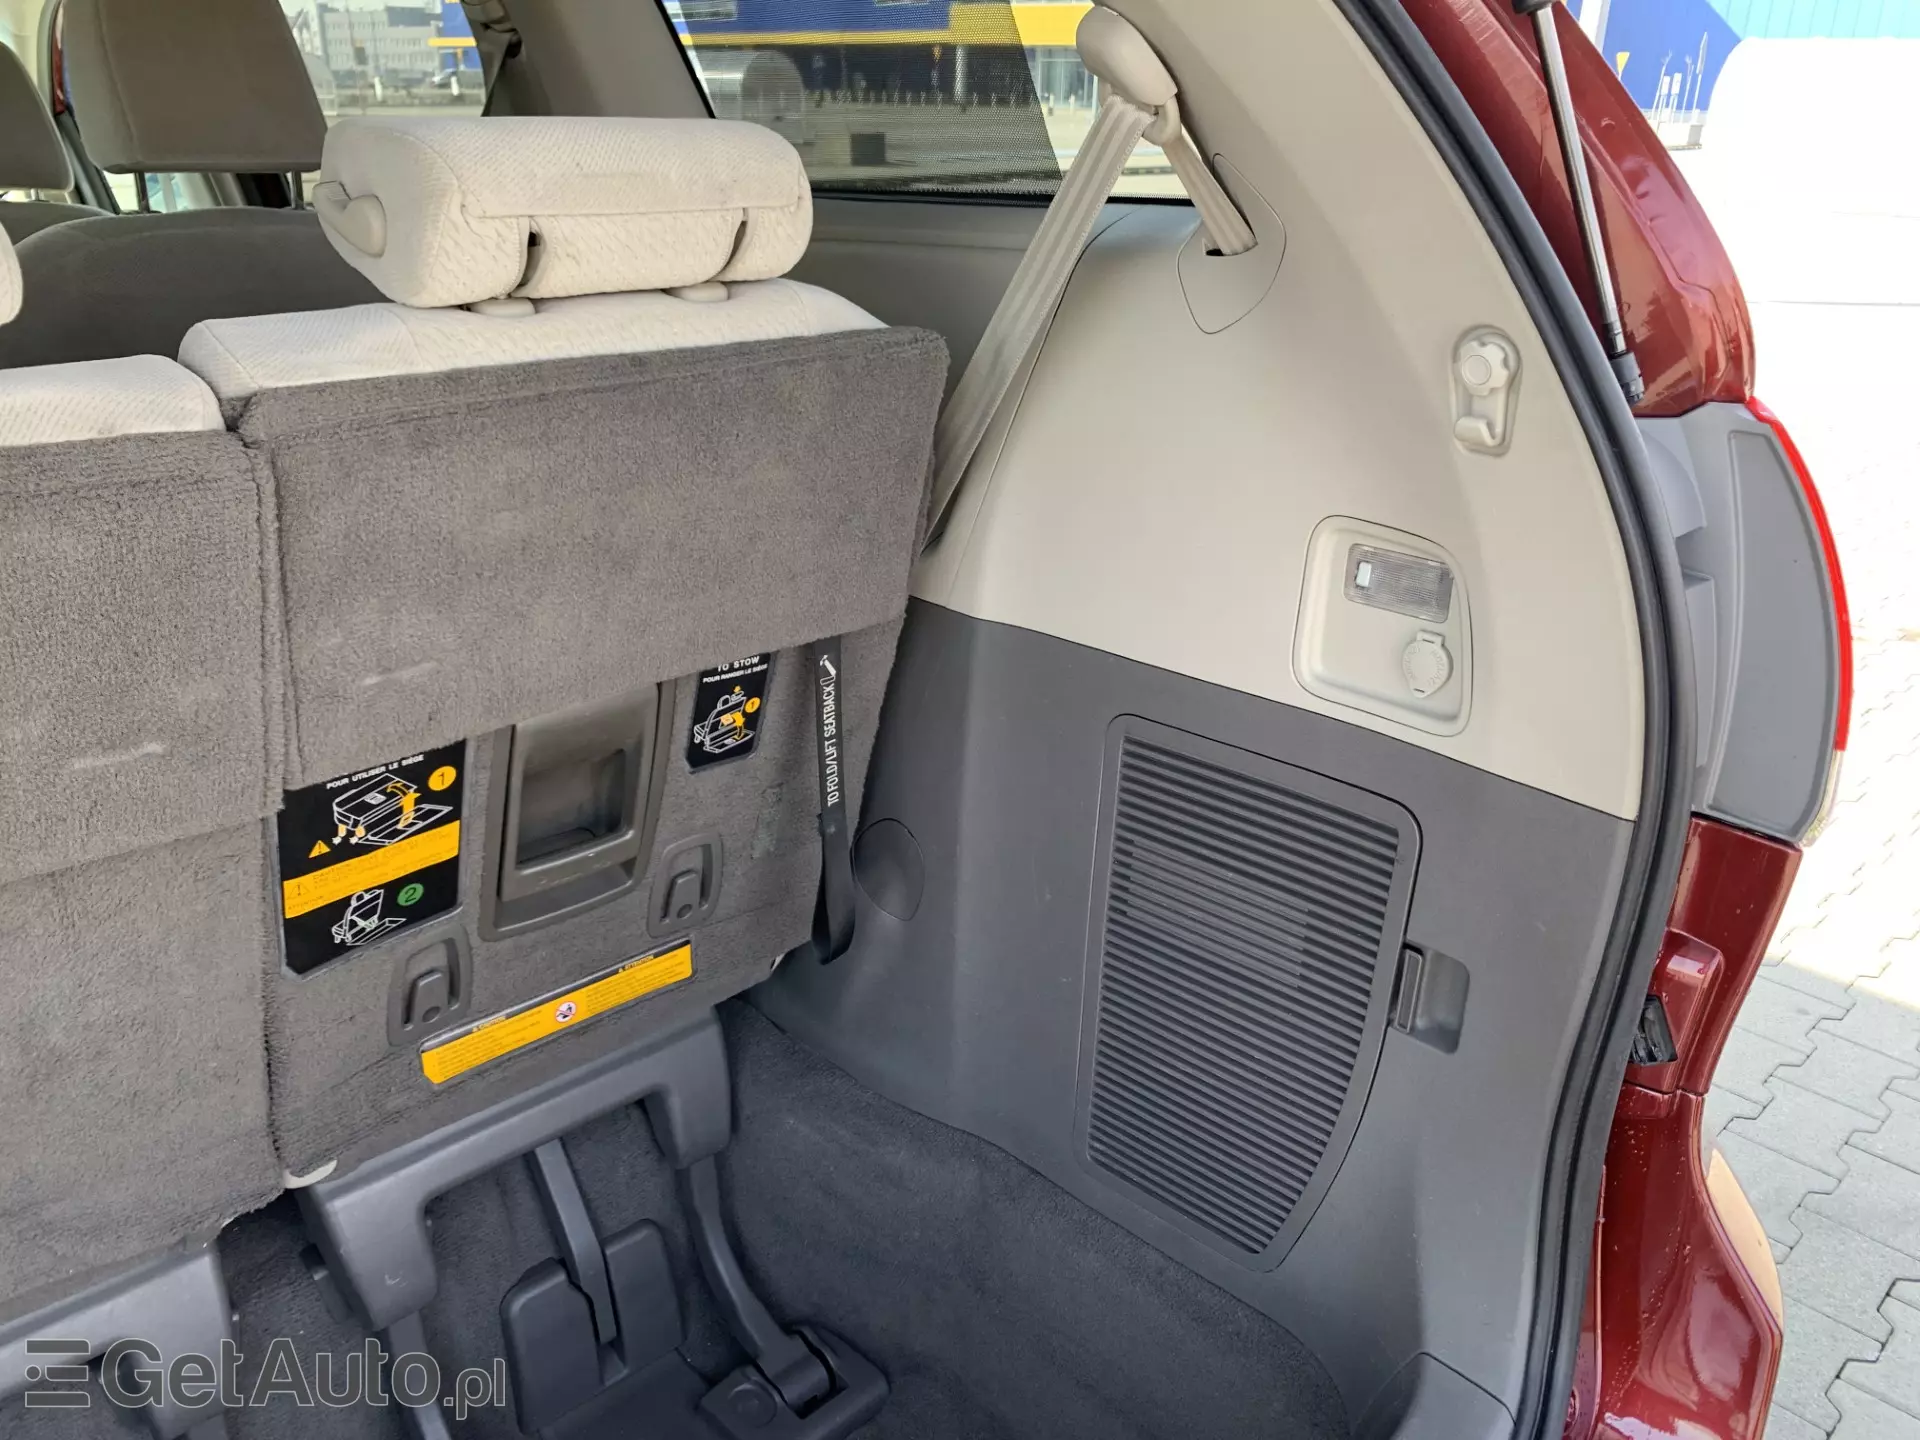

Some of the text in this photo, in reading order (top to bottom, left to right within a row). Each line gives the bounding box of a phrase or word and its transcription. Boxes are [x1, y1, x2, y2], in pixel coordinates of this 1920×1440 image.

[734, 655, 760, 669] STOW
[703, 675, 721, 683] POUR
[822, 685, 836, 738] SEATBACK
[326, 777, 350, 790] POUR
[351, 766, 387, 782] UTILISER
[388, 761, 400, 770] LE
[827, 791, 840, 807] TO
[404, 887, 418, 904] 2
